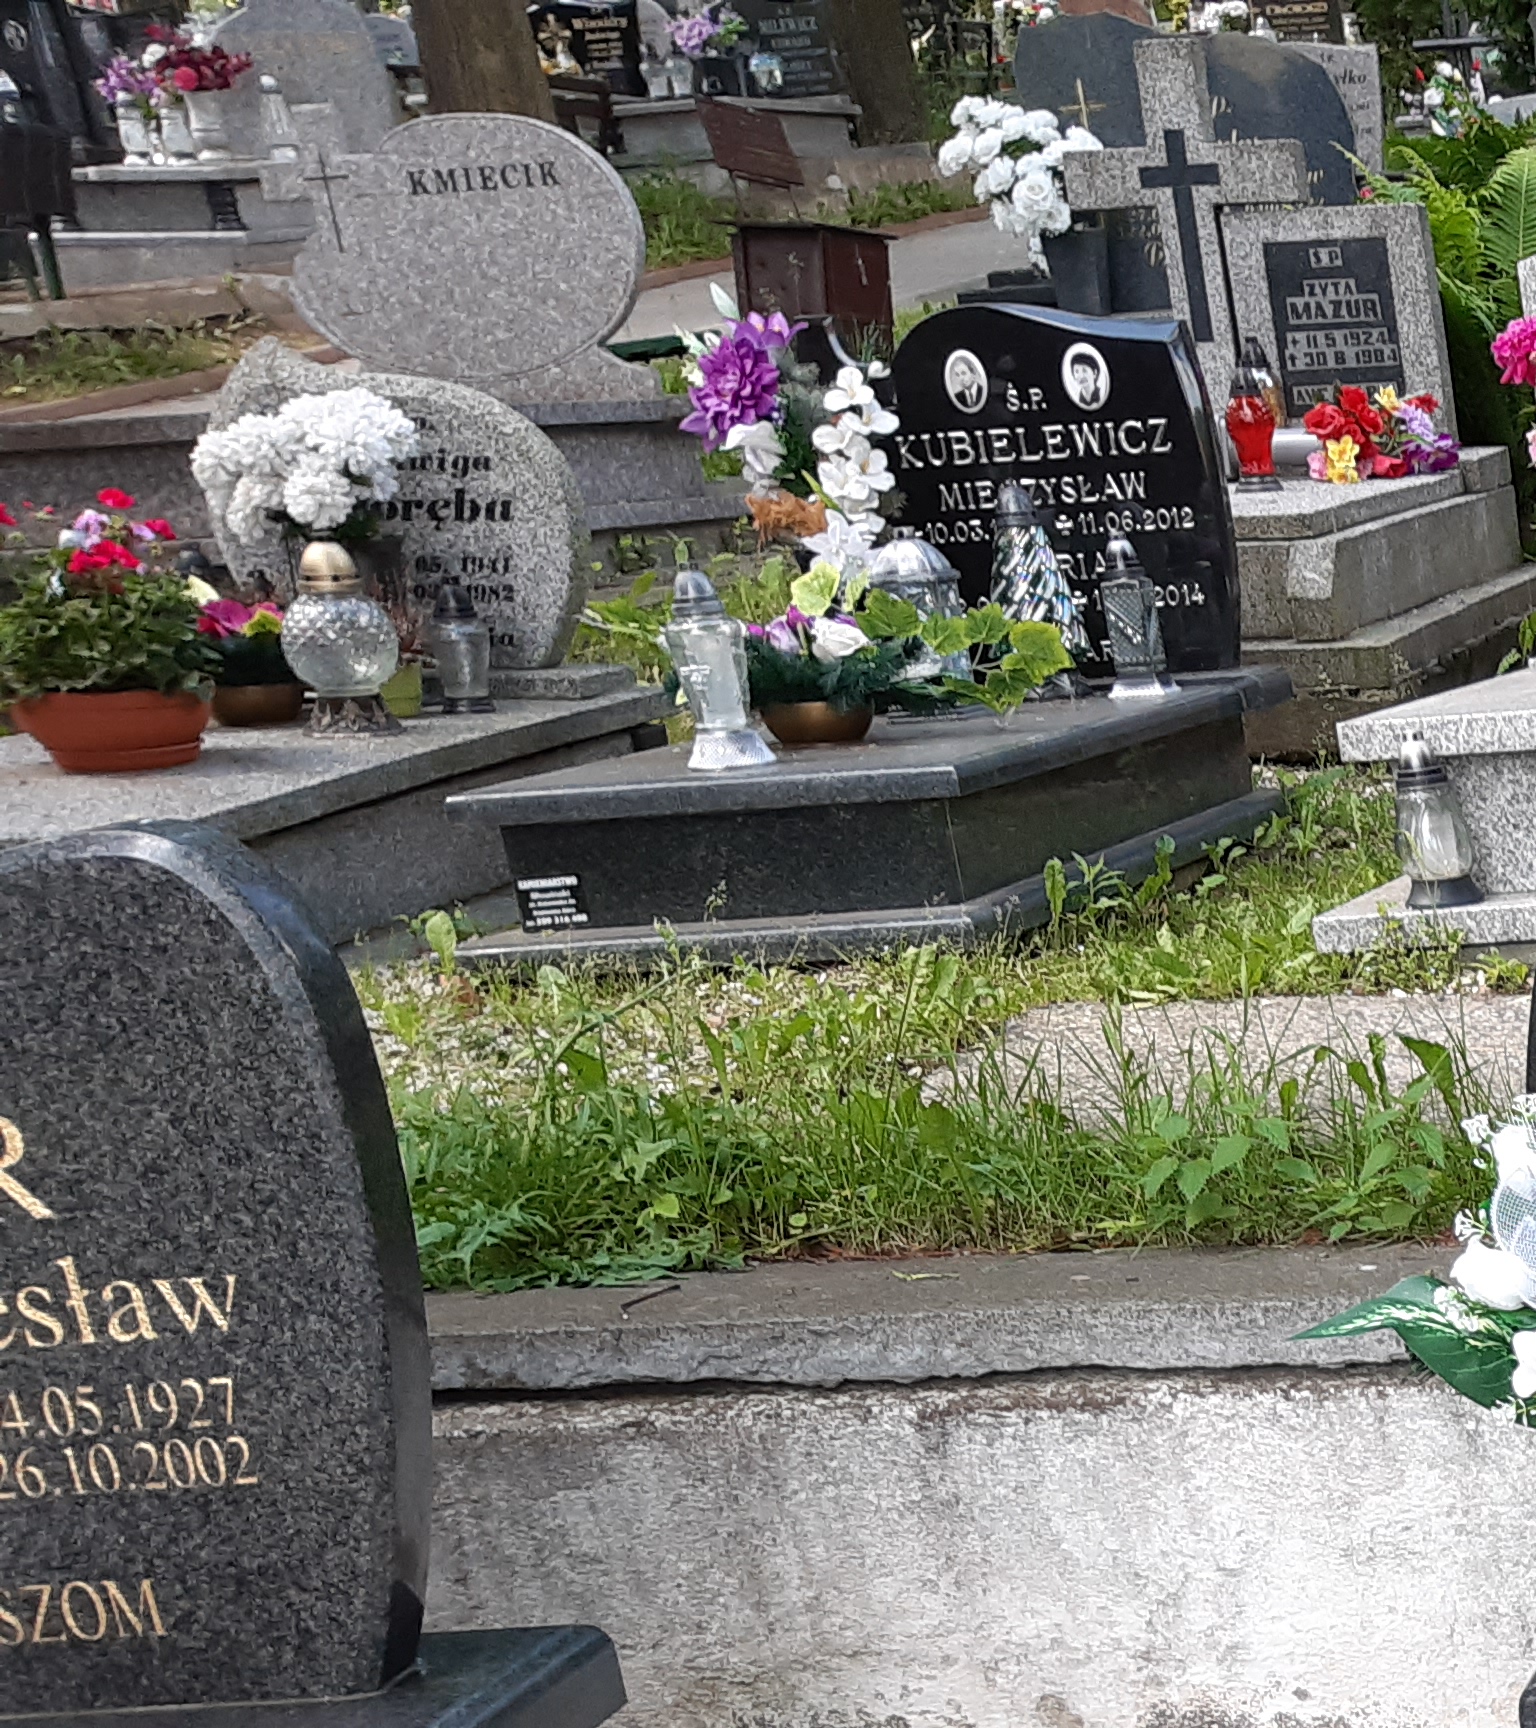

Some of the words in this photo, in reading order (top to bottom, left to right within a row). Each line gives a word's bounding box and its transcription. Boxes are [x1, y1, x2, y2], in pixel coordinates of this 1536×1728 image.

[407, 160, 561, 195] KMIECIK
[1305, 280, 1355, 297] ZYTA
[1289, 298, 1380, 320] MAZUR
[894, 417, 1173, 469] KUBIELEWICZ
[938, 470, 1147, 512] MIEZYSŁAW
[1077, 506, 1195, 536] 11.06.2012
